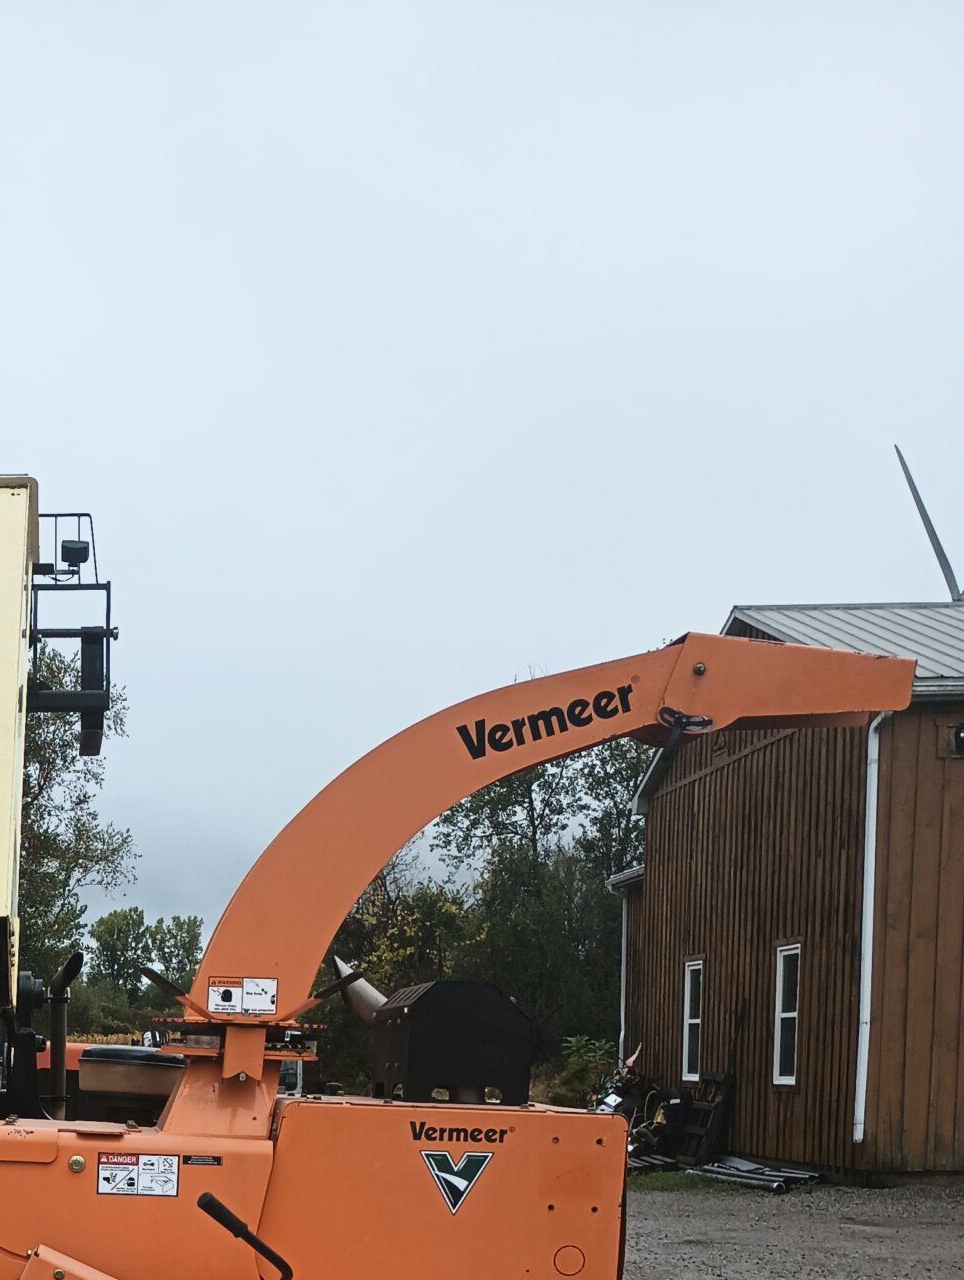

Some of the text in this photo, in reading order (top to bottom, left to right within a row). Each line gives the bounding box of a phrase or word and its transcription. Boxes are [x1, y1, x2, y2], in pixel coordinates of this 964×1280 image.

[455, 684, 633, 761] Vermeer
[409, 1120, 508, 1144] Vermeer
[108, 1155, 137, 1164] DANGER
